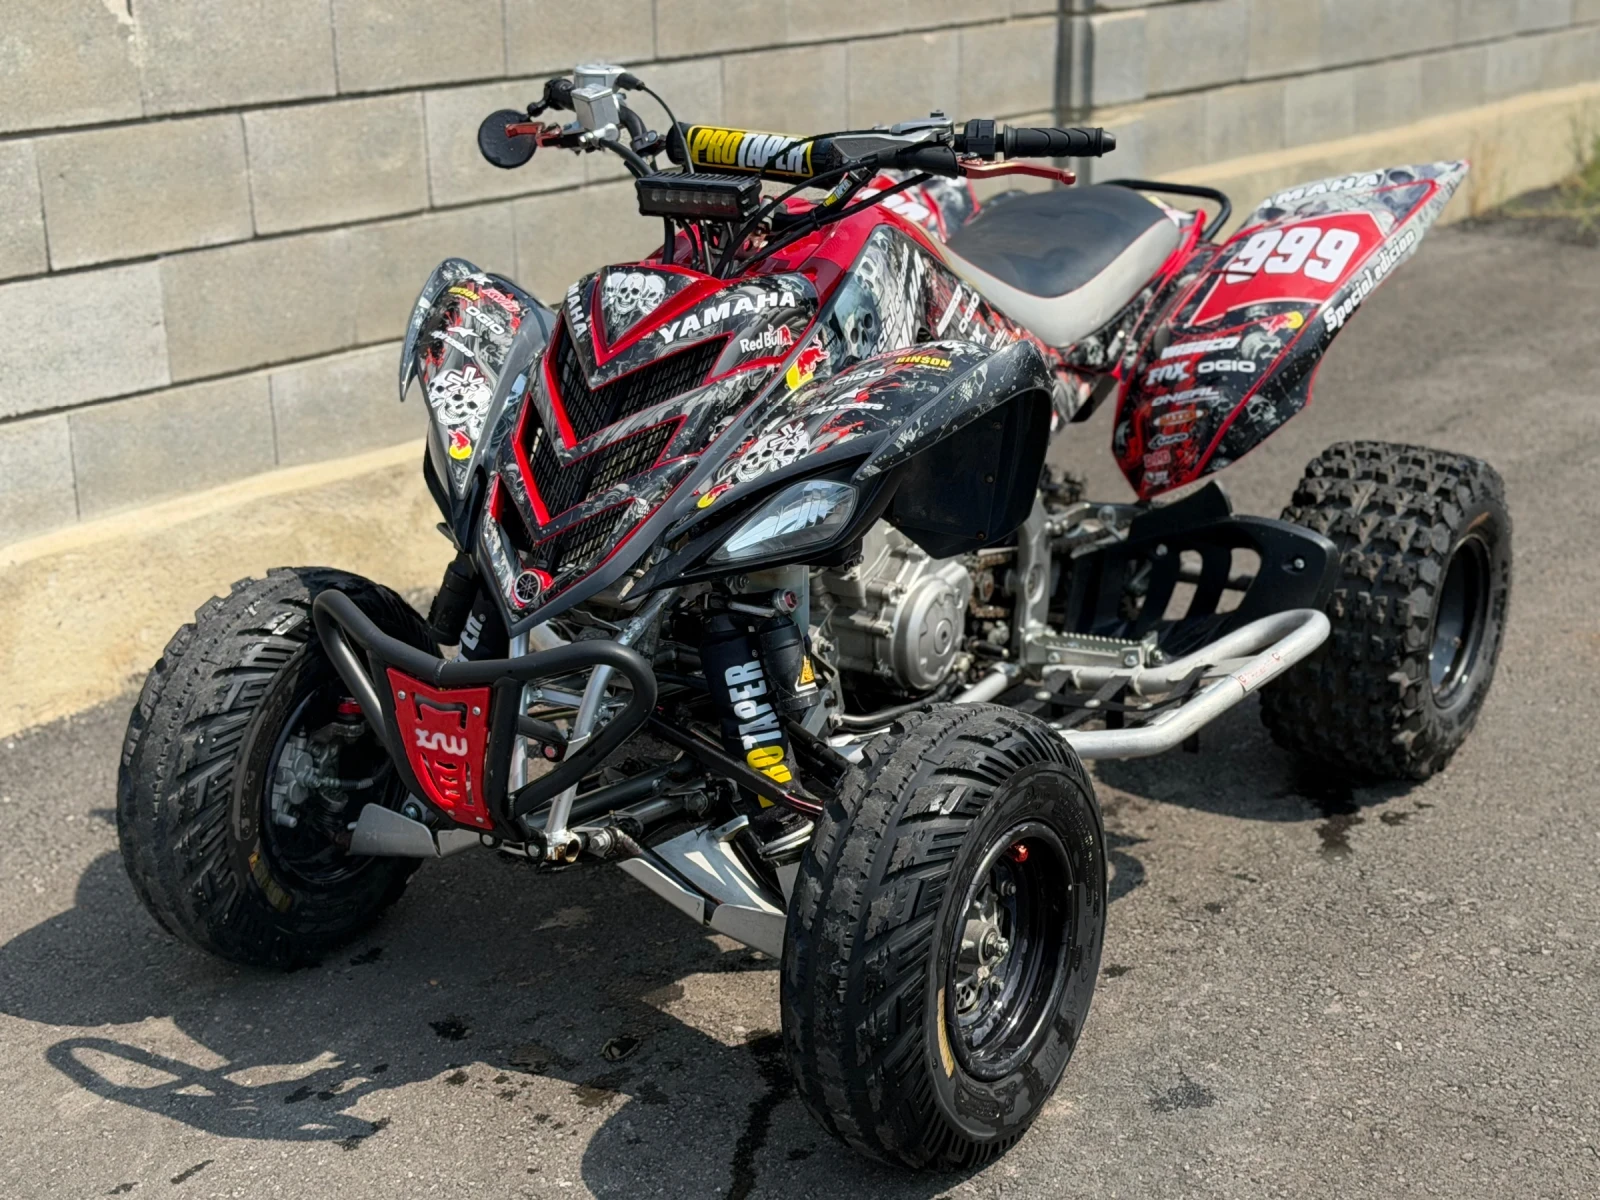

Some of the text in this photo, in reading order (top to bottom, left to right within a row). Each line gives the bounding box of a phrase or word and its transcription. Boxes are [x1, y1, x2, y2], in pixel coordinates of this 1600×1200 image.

[1225, 227, 1360, 283] 999
[466, 305, 505, 335] OGIO
[567, 281, 588, 338] MAHA
[658, 291, 796, 345] YAMAHA
[1323, 270, 1374, 332] Special
[1197, 359, 1256, 374] OGIO
